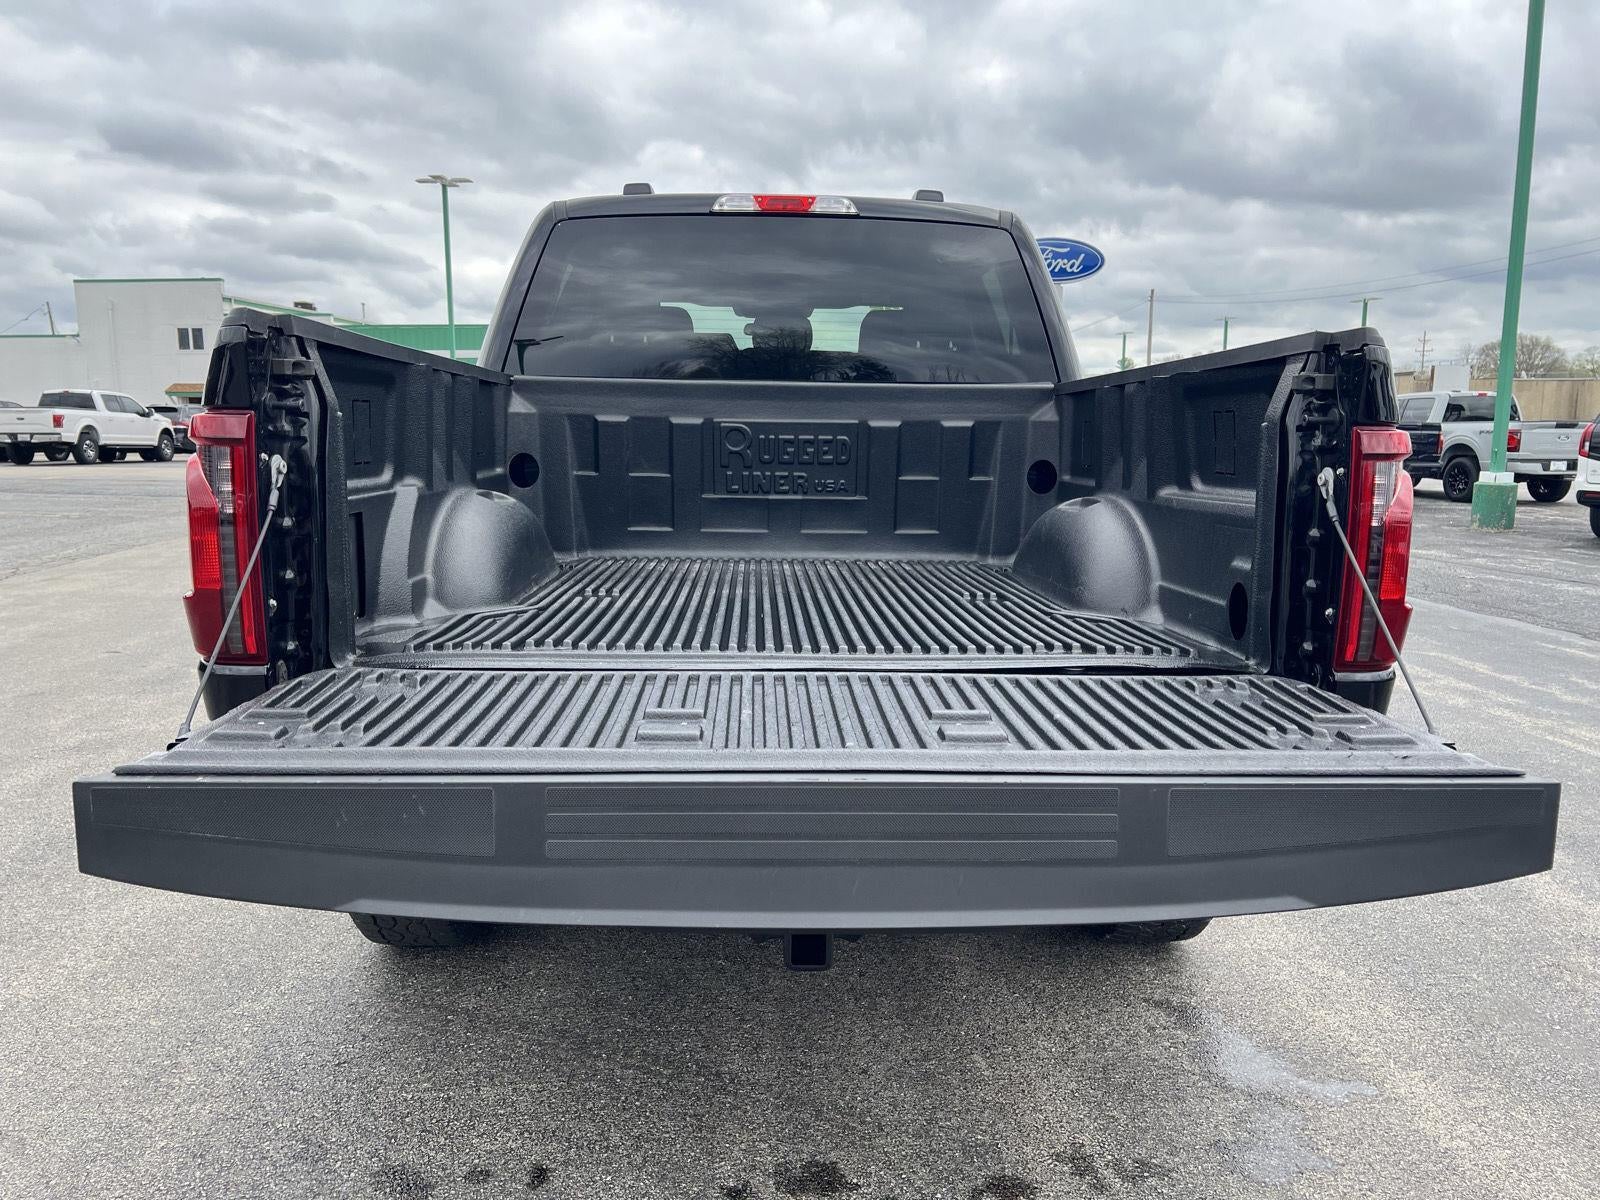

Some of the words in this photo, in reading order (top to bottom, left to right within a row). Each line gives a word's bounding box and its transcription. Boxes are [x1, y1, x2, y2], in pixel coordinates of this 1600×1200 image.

[720, 423, 851, 468] RUGGED
[726, 471, 809, 494] LINER
[814, 479, 849, 493] USA
